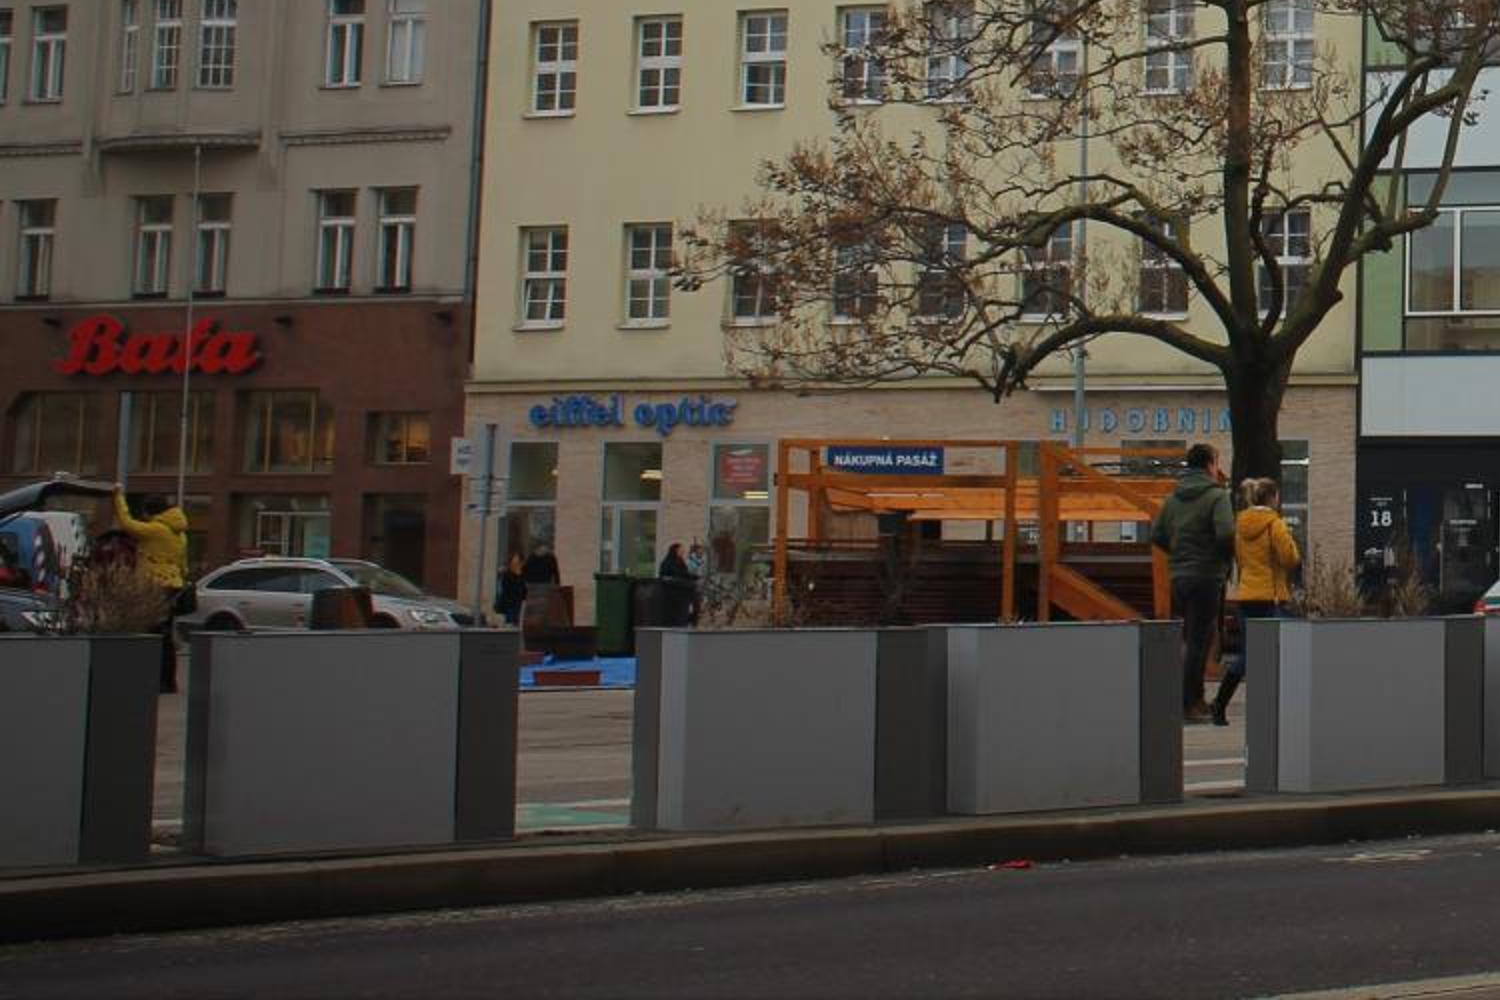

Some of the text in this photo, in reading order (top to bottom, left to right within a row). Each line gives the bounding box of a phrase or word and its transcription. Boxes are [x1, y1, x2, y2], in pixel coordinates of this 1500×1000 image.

[528, 392, 738, 437] eiffel optic
[832, 450, 894, 467] NÁKUPNÁ
[1370, 509, 1394, 528] 18
